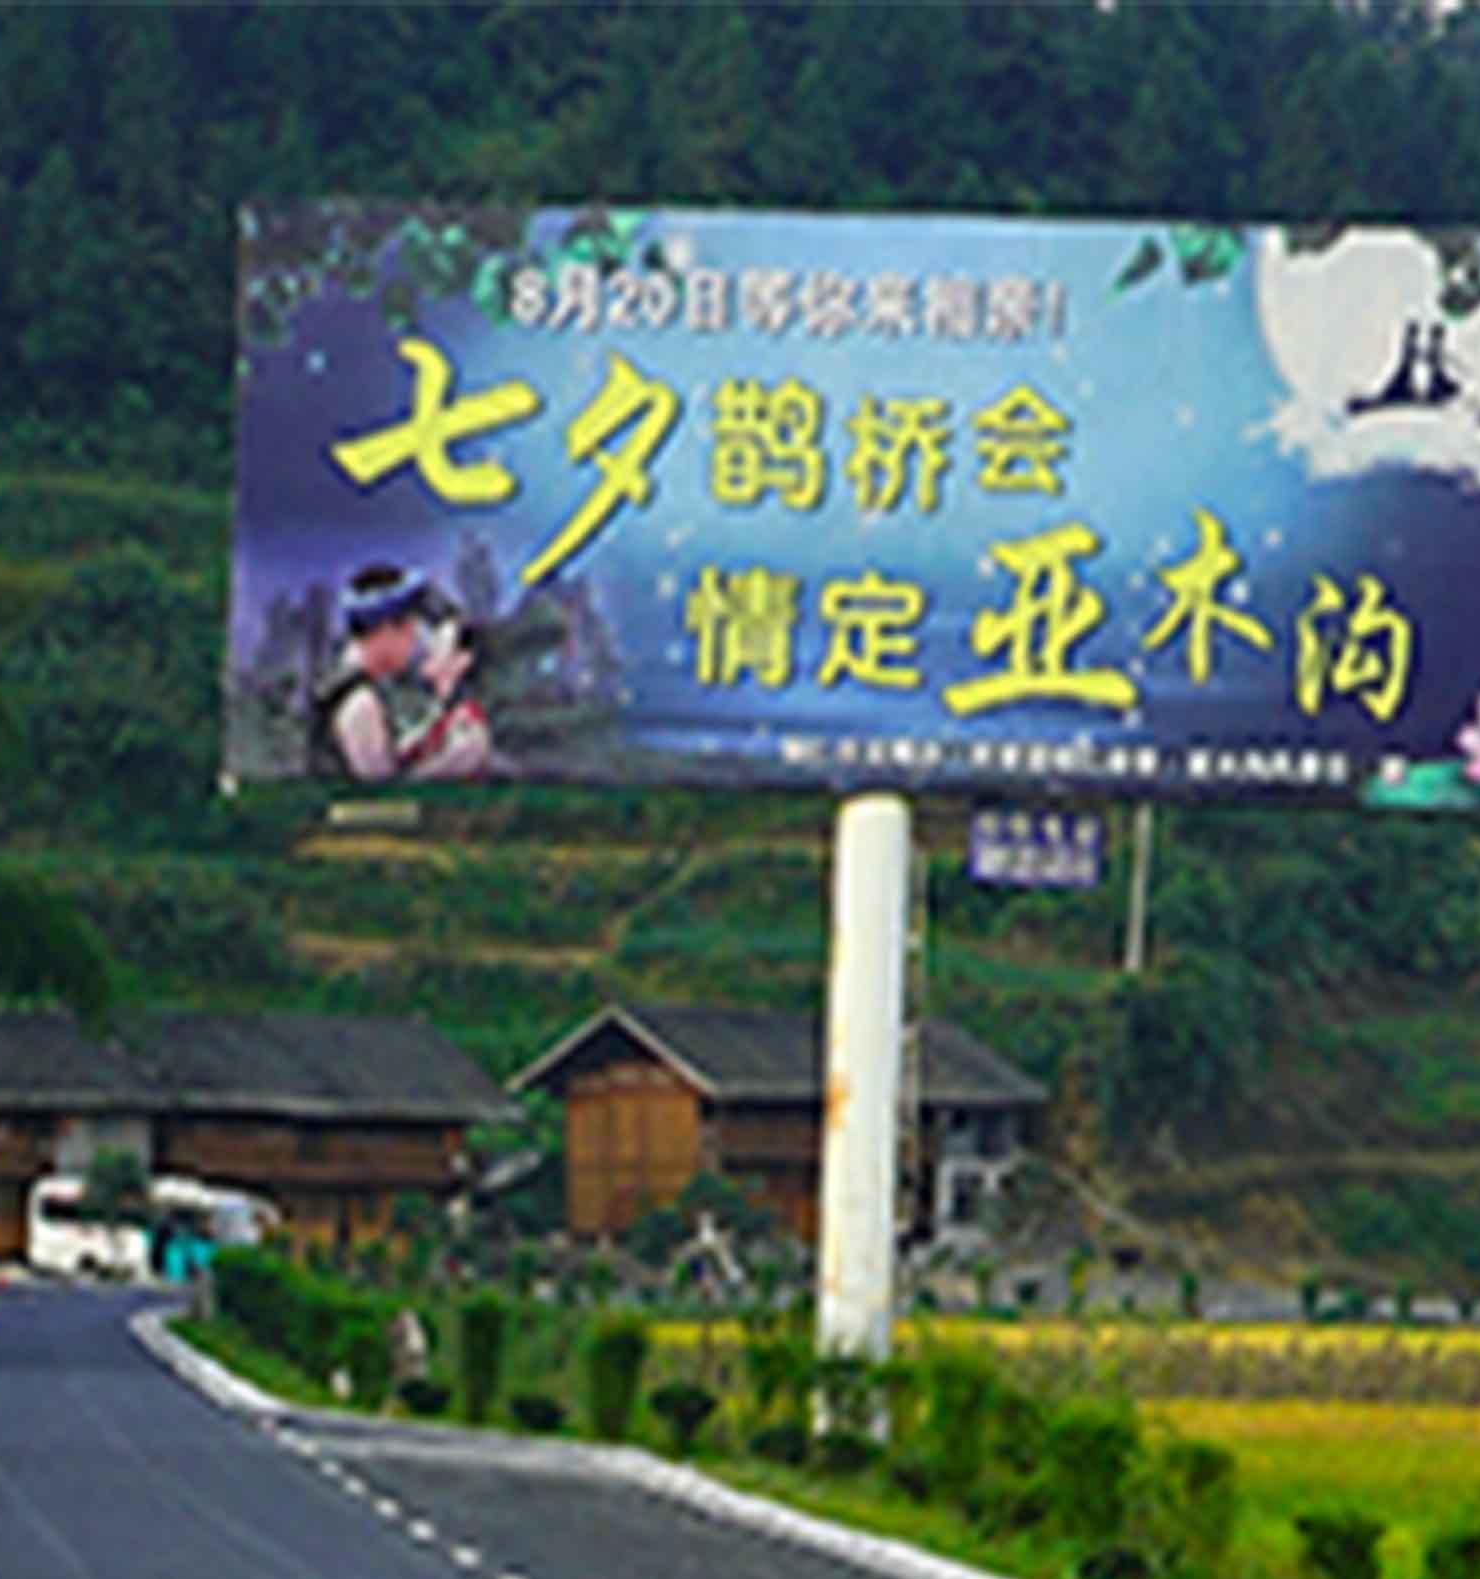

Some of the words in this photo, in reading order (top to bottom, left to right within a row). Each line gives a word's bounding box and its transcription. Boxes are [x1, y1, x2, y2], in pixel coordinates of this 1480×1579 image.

[330, 337, 1070, 587] 七夕鹊桥会
[685, 506, 1413, 720] 情定亚木沟
